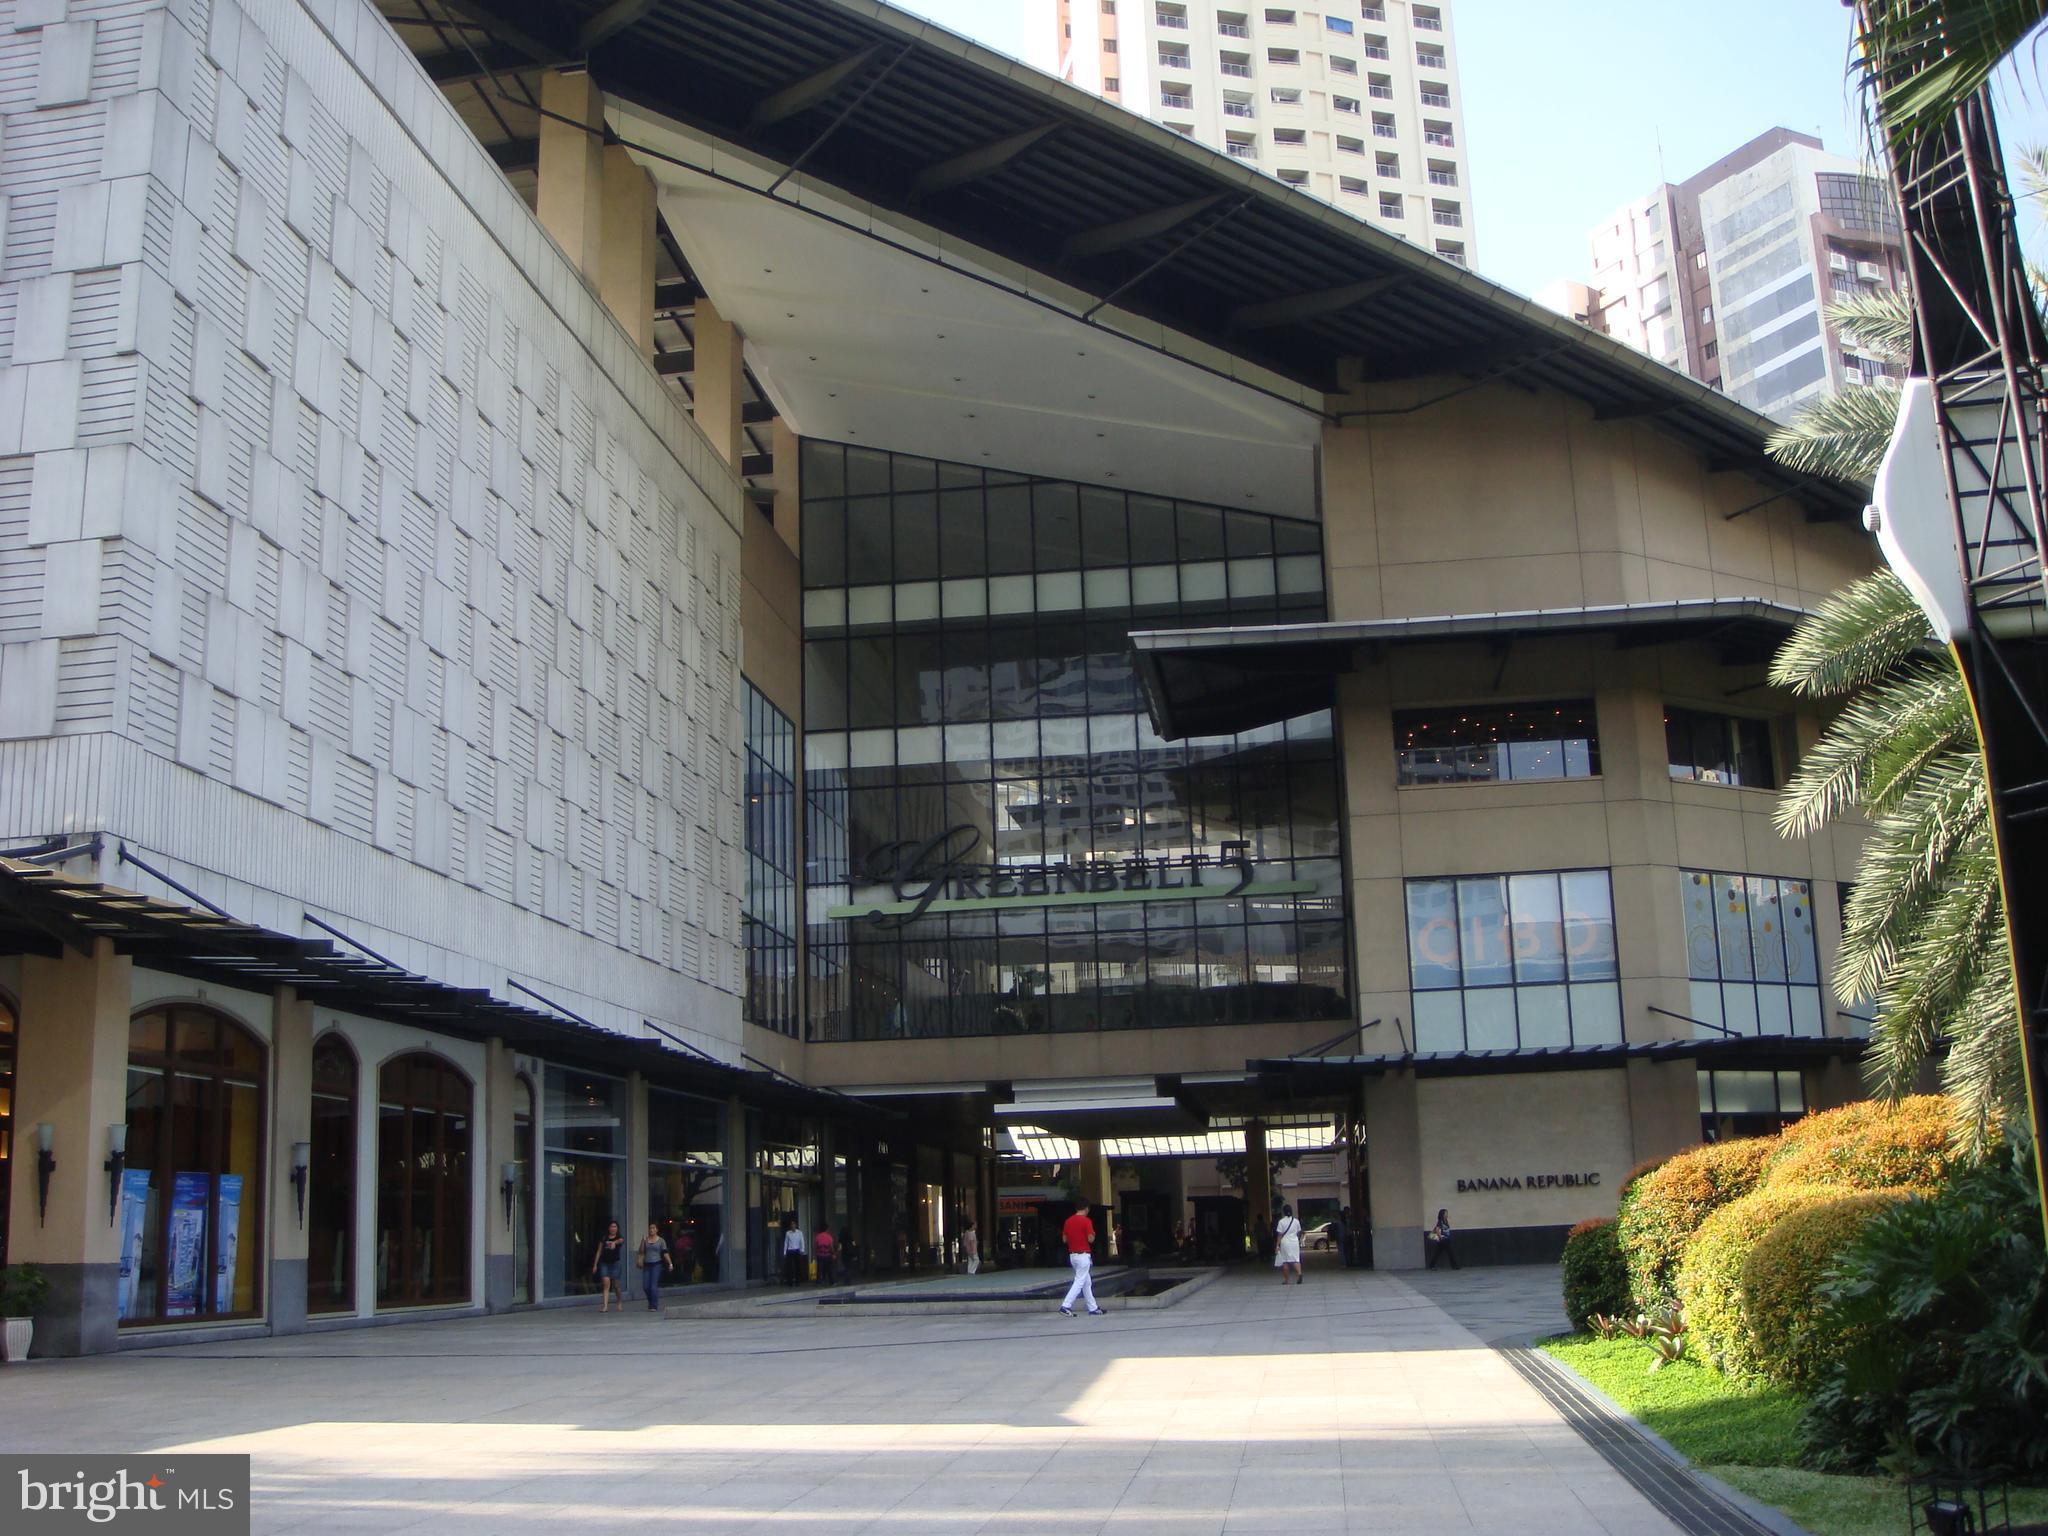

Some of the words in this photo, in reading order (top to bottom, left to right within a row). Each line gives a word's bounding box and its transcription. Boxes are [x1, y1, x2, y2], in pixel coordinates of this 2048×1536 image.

[1220, 840, 1255, 896] 5
[1419, 911, 1598, 963] CIBO
[1689, 924, 1802, 976] CIBO
[1457, 1176, 1521, 1193] BANANA
[1527, 1173, 1601, 1188] REPUBLIC
